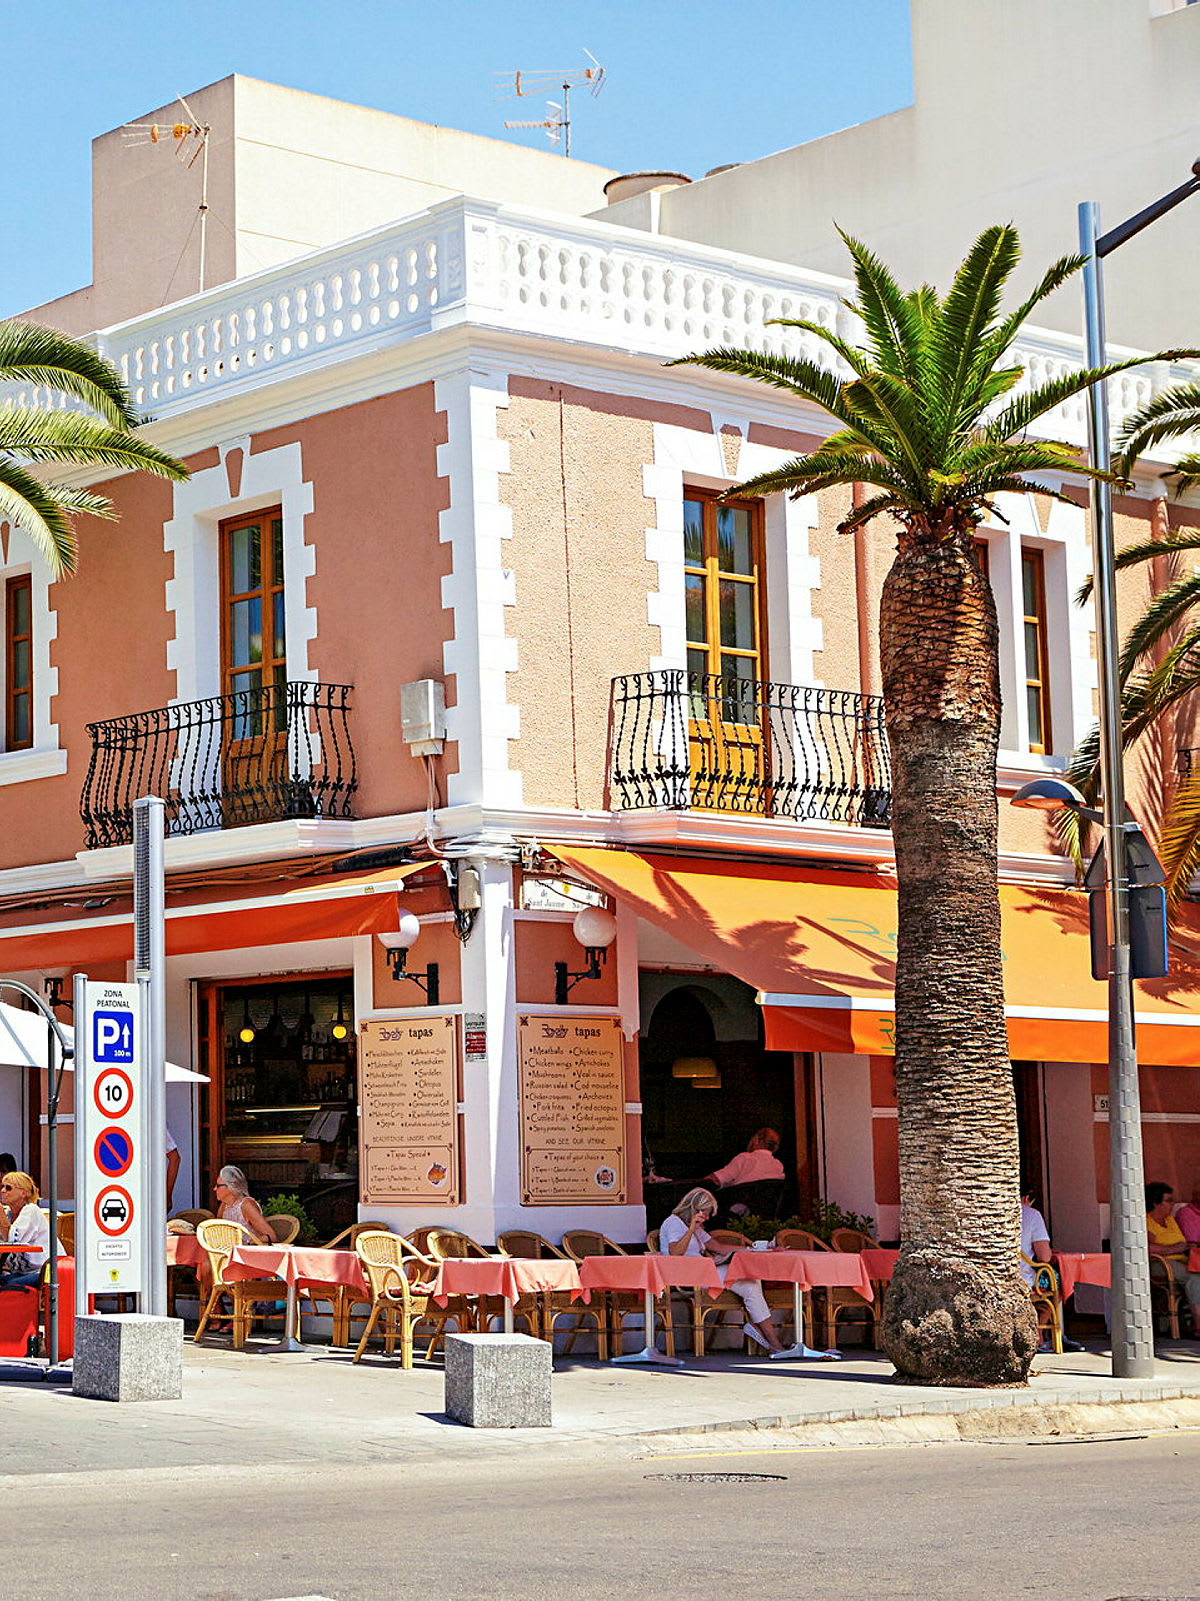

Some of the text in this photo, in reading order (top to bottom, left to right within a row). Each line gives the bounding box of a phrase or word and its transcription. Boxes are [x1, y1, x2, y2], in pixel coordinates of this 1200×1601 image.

[104, 990, 122, 998] ZONA
[96, 1000, 130, 1008] PEATONAL
[98, 1018, 120, 1056] P
[408, 1028, 434, 1040] tapas
[575, 1027, 601, 1040] tapas
[533, 1046, 564, 1056] Meatballs
[573, 1046, 597, 1056] Chicken
[528, 1057, 554, 1068] Chicken
[532, 1070, 566, 1078] Mushrooms
[554, 1081, 568, 1089] salad
[574, 1080, 589, 1090] Cod
[105, 1085, 122, 1102] 10
[576, 1102, 592, 1111] Fried
[548, 1152, 566, 1162] Tapas
